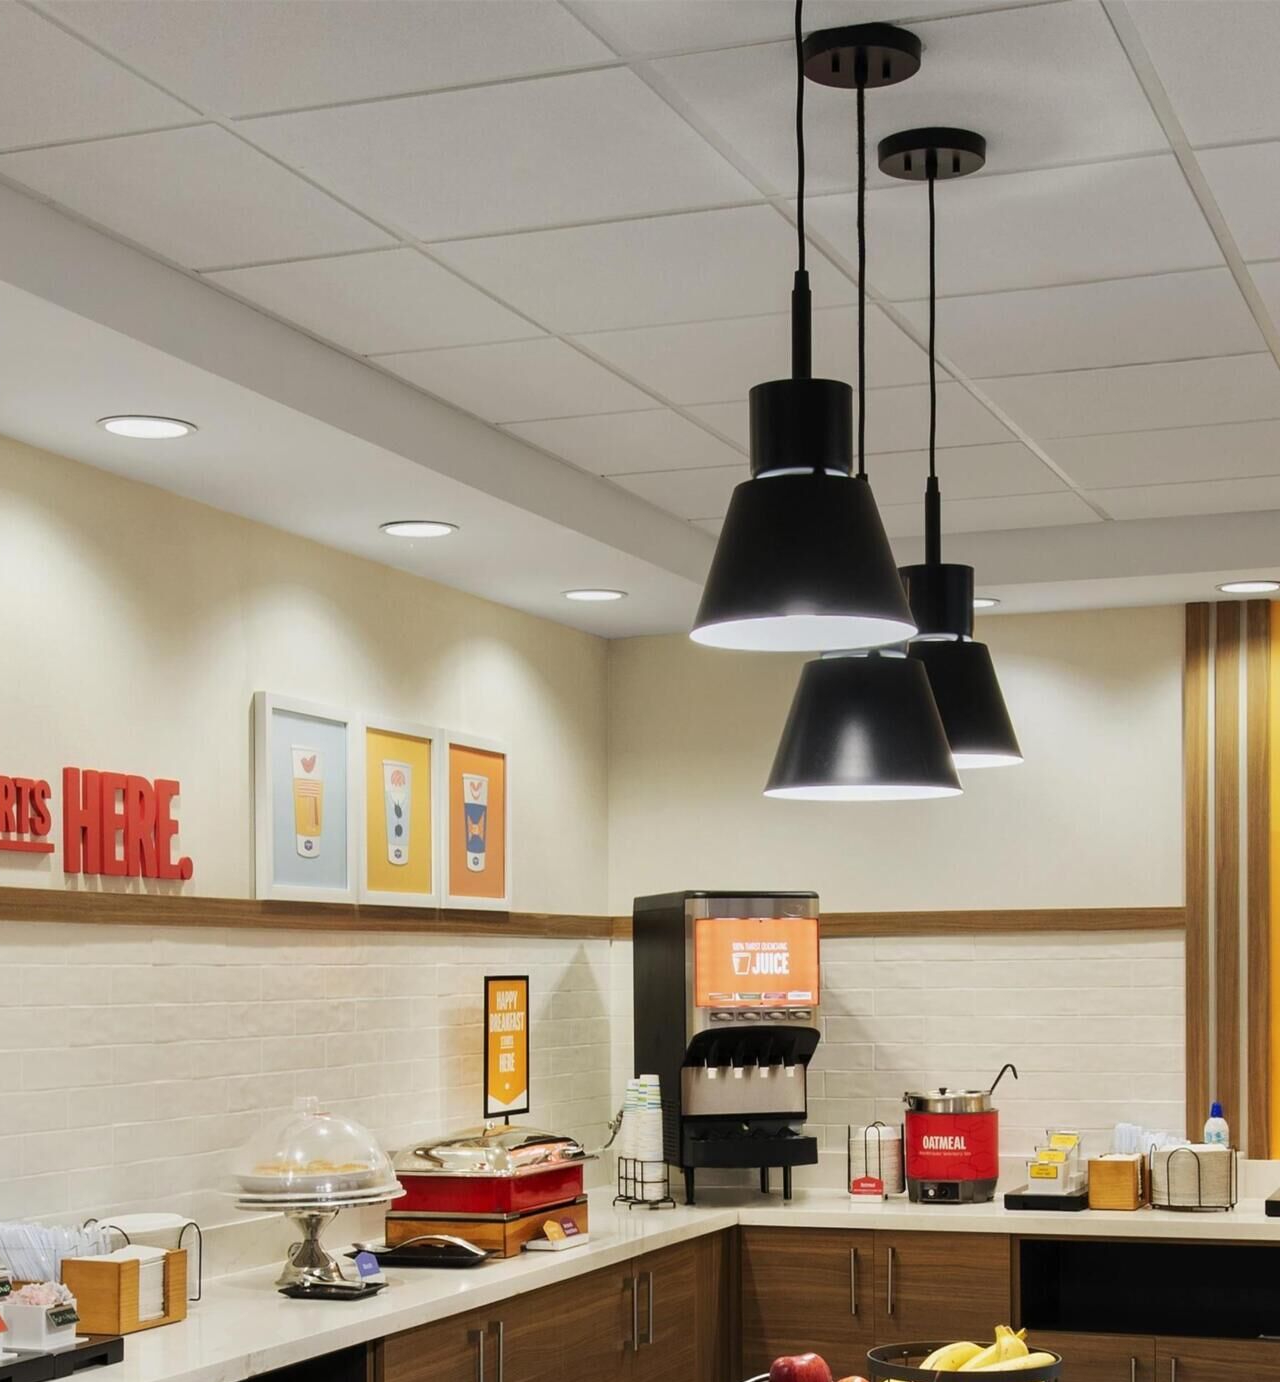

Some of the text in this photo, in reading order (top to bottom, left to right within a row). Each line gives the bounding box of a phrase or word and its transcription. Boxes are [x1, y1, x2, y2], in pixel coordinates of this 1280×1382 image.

[63, 767, 193, 880] HERE.
[751, 952, 790, 975] JUICE
[496, 990, 518, 1011] HAPPY
[489, 1011, 524, 1032] BREAKFAST
[922, 1135, 967, 1151] OATMEAL
